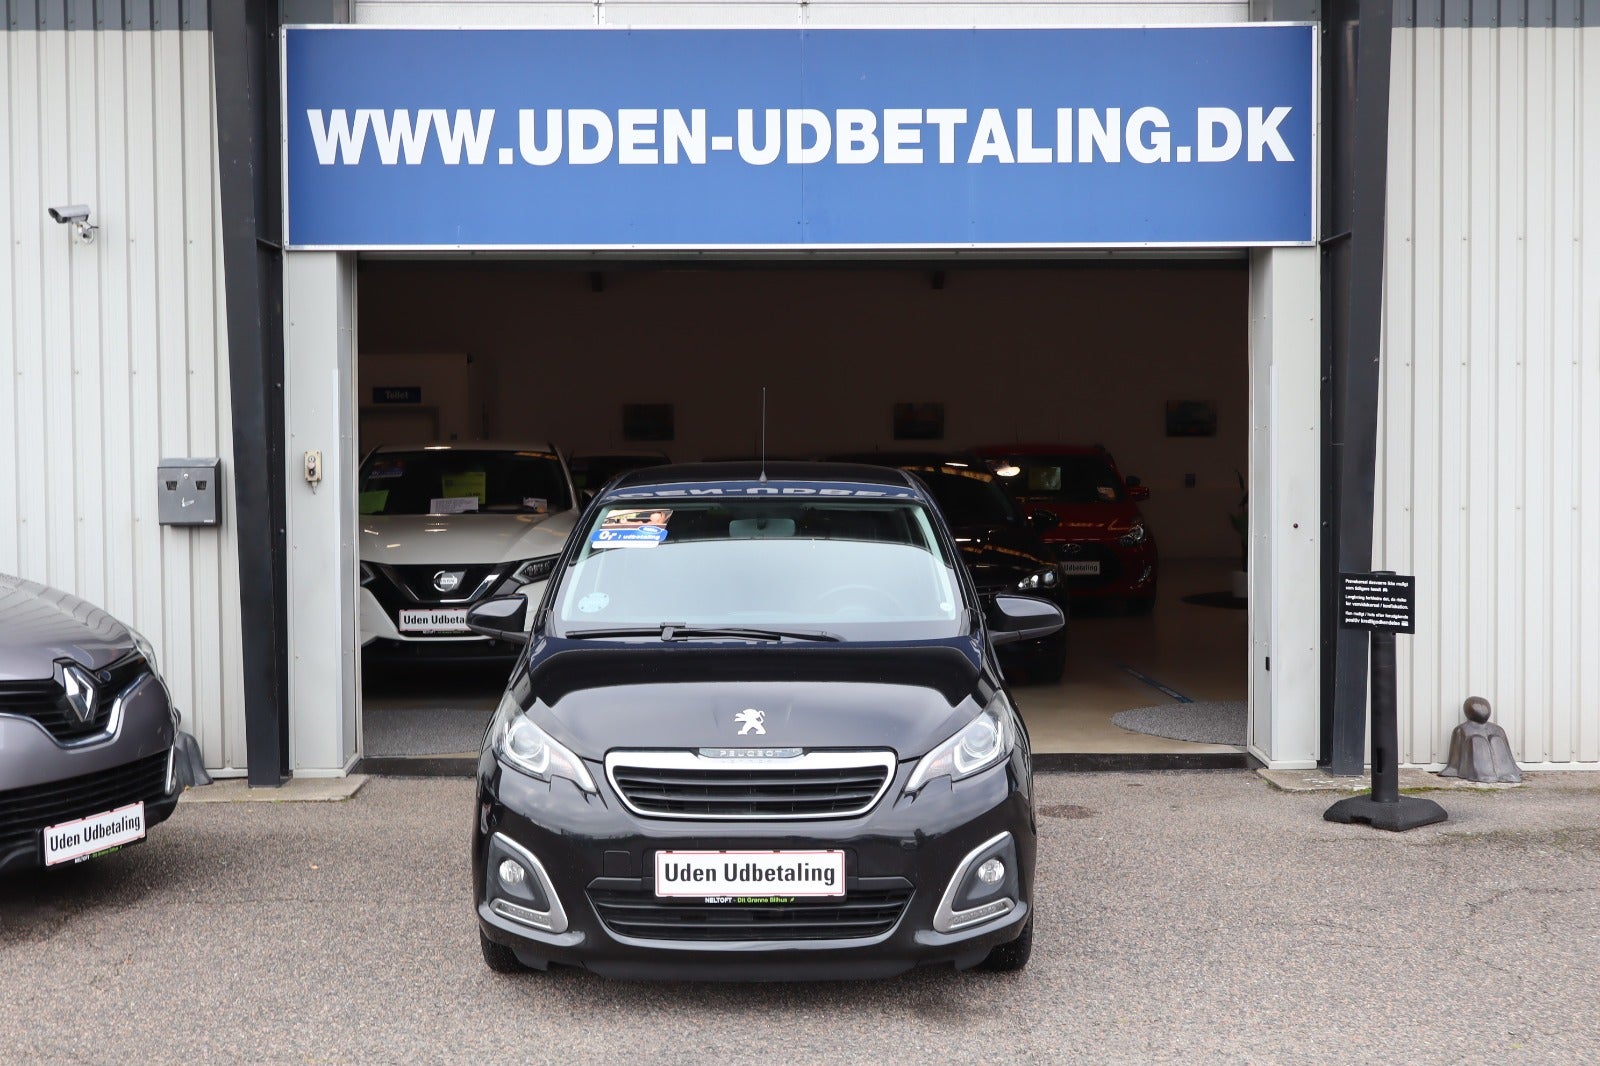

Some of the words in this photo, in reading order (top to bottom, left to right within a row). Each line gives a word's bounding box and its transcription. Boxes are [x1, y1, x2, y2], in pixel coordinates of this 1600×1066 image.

[306, 106, 1295, 166] WWW.UDEN-UDBETALING.DK
[404, 615, 428, 624] Uden
[431, 615, 465, 624] Udbeta
[50, 832, 80, 852] Uden
[83, 816, 141, 842] Udbetaling
[664, 863, 717, 882] Uden
[724, 862, 835, 886] Udbetaling
